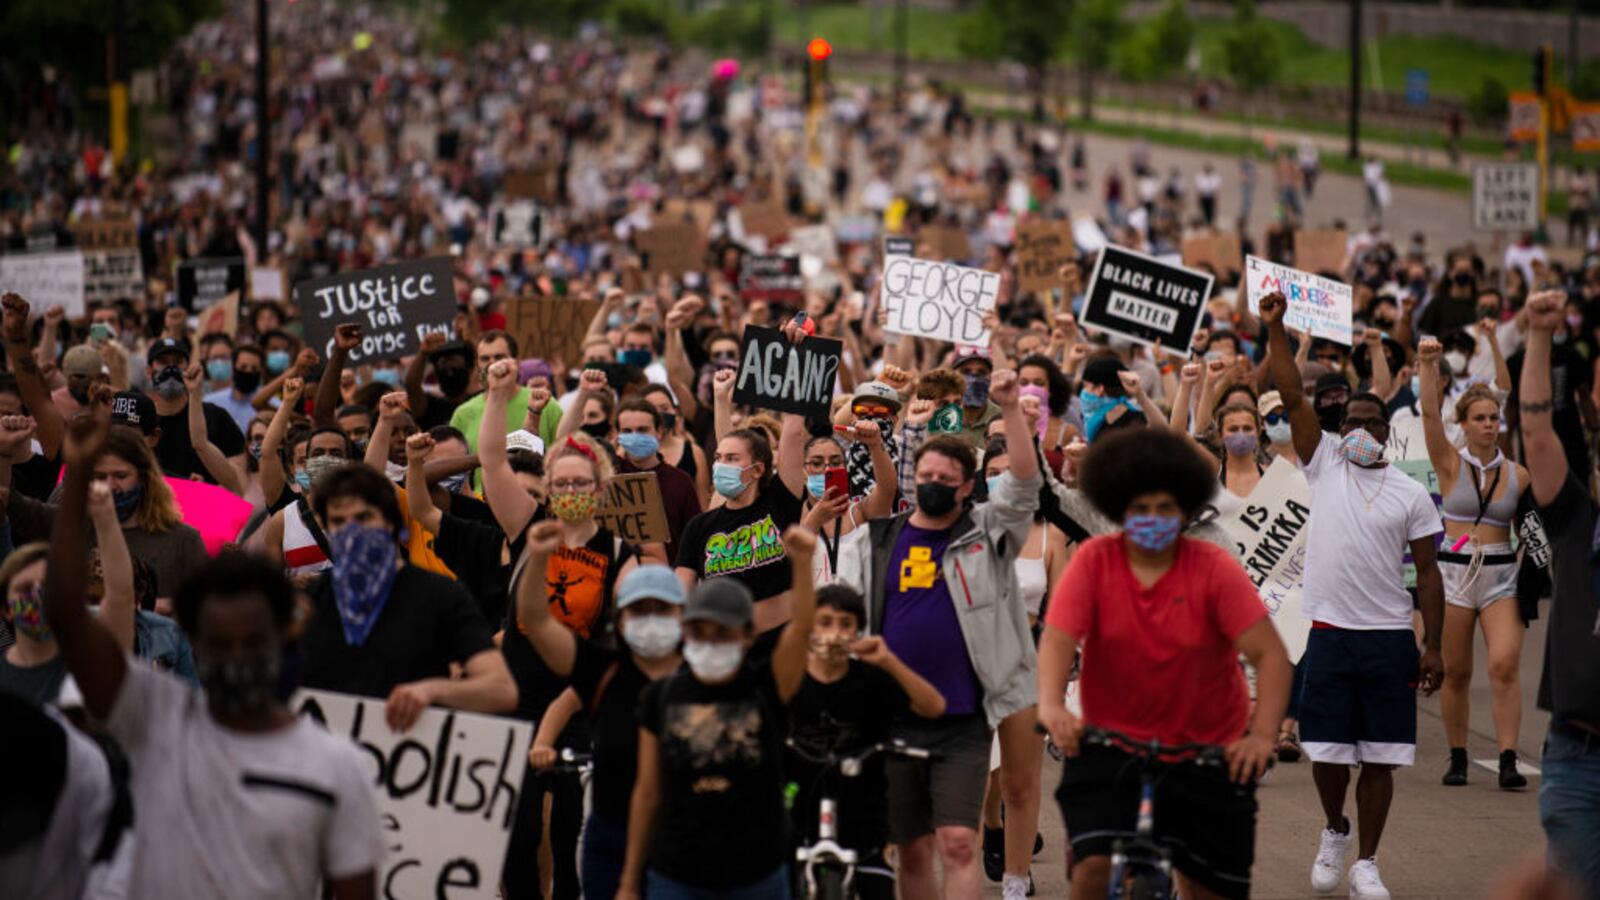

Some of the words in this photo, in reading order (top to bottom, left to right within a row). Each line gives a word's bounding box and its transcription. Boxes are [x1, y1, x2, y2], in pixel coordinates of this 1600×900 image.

[1482, 190, 1531, 203] TURN
[1484, 171, 1527, 184] LEFT
[1480, 210, 1528, 224] LANE
[885, 259, 996, 312] GEORGE
[1102, 263, 1154, 293] BLACK
[1156, 280, 1200, 307] LIVES
[886, 294, 985, 341] FLOYD
[1114, 297, 1172, 328] MATTER
[737, 338, 840, 404] AGAIN?
[604, 477, 649, 509] ANT
[705, 514, 777, 559] 90210
[1239, 505, 1269, 532] IS
[1247, 499, 1310, 592] ERIKKKA
